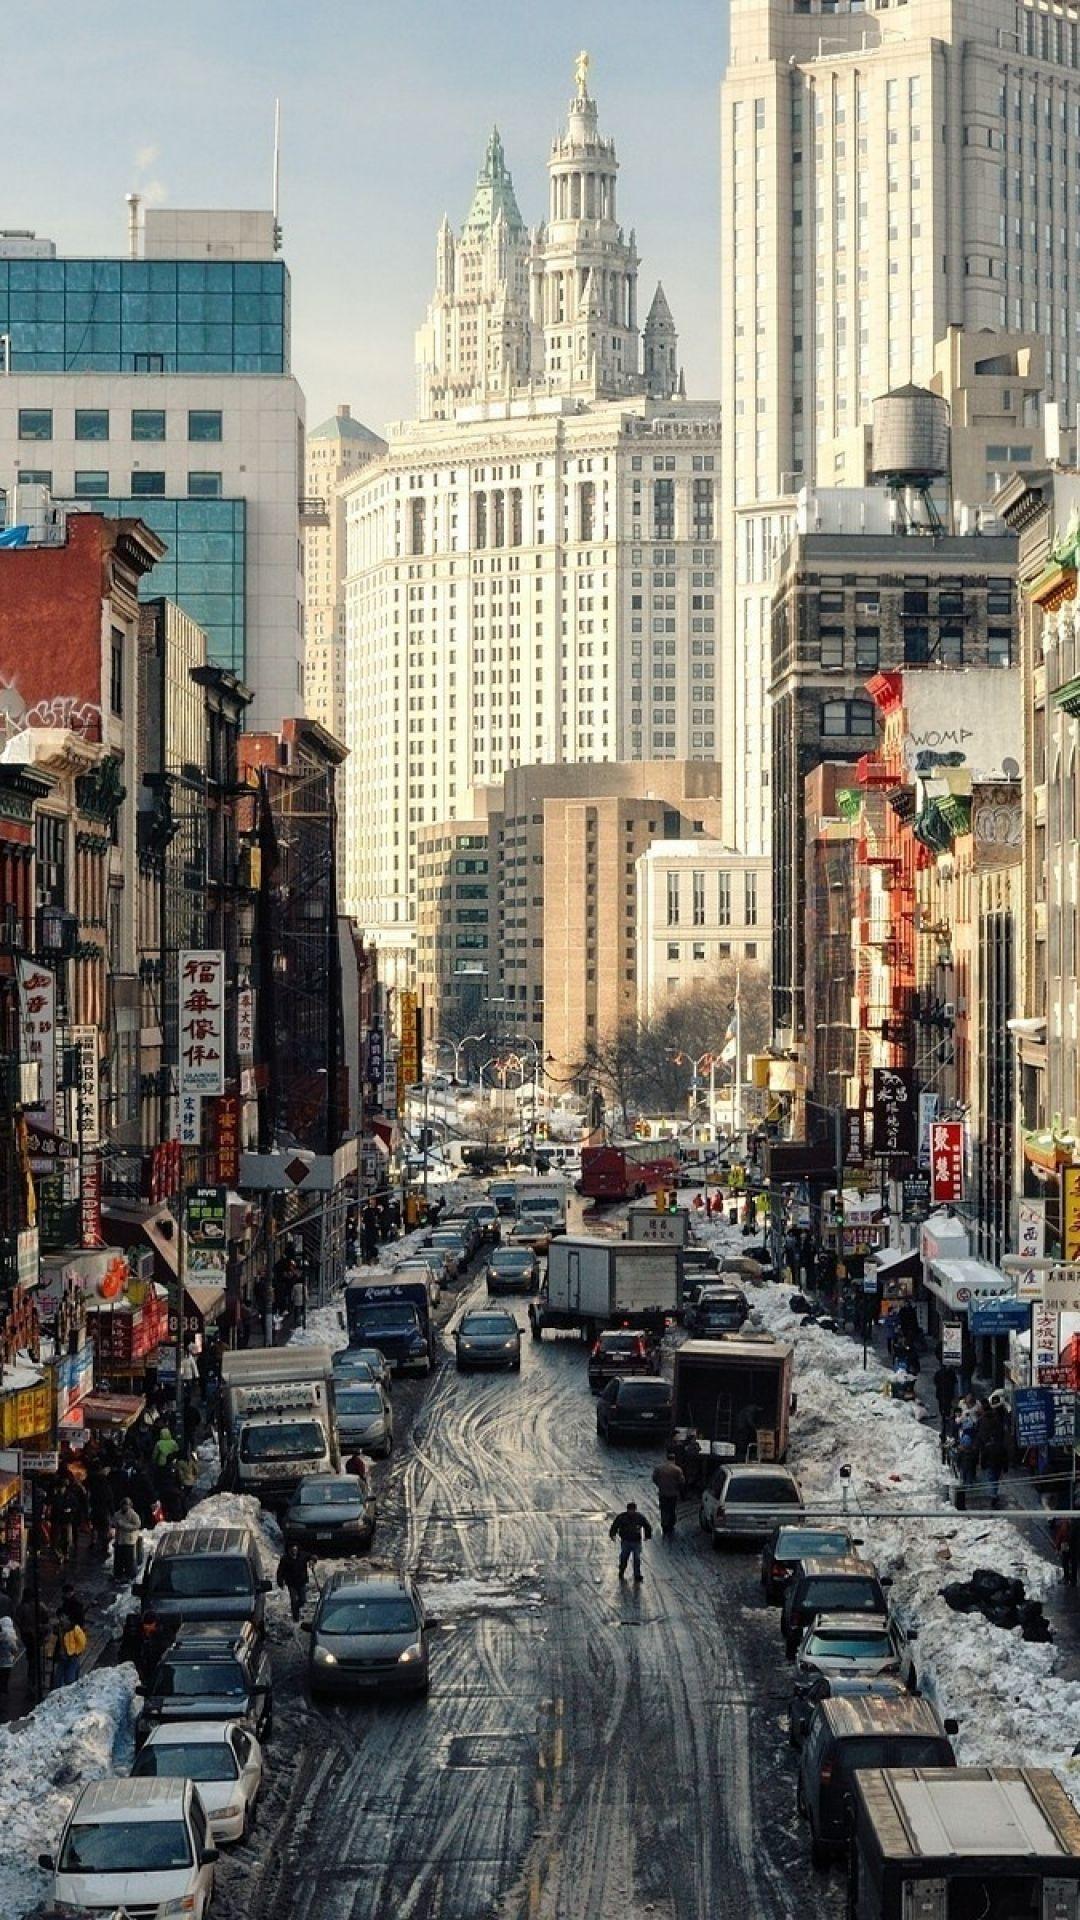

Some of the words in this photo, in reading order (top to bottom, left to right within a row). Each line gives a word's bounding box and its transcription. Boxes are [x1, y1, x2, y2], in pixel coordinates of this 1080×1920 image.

[910, 729, 974, 746] WOMP
[182, 960, 221, 1068] 福華傢俬
